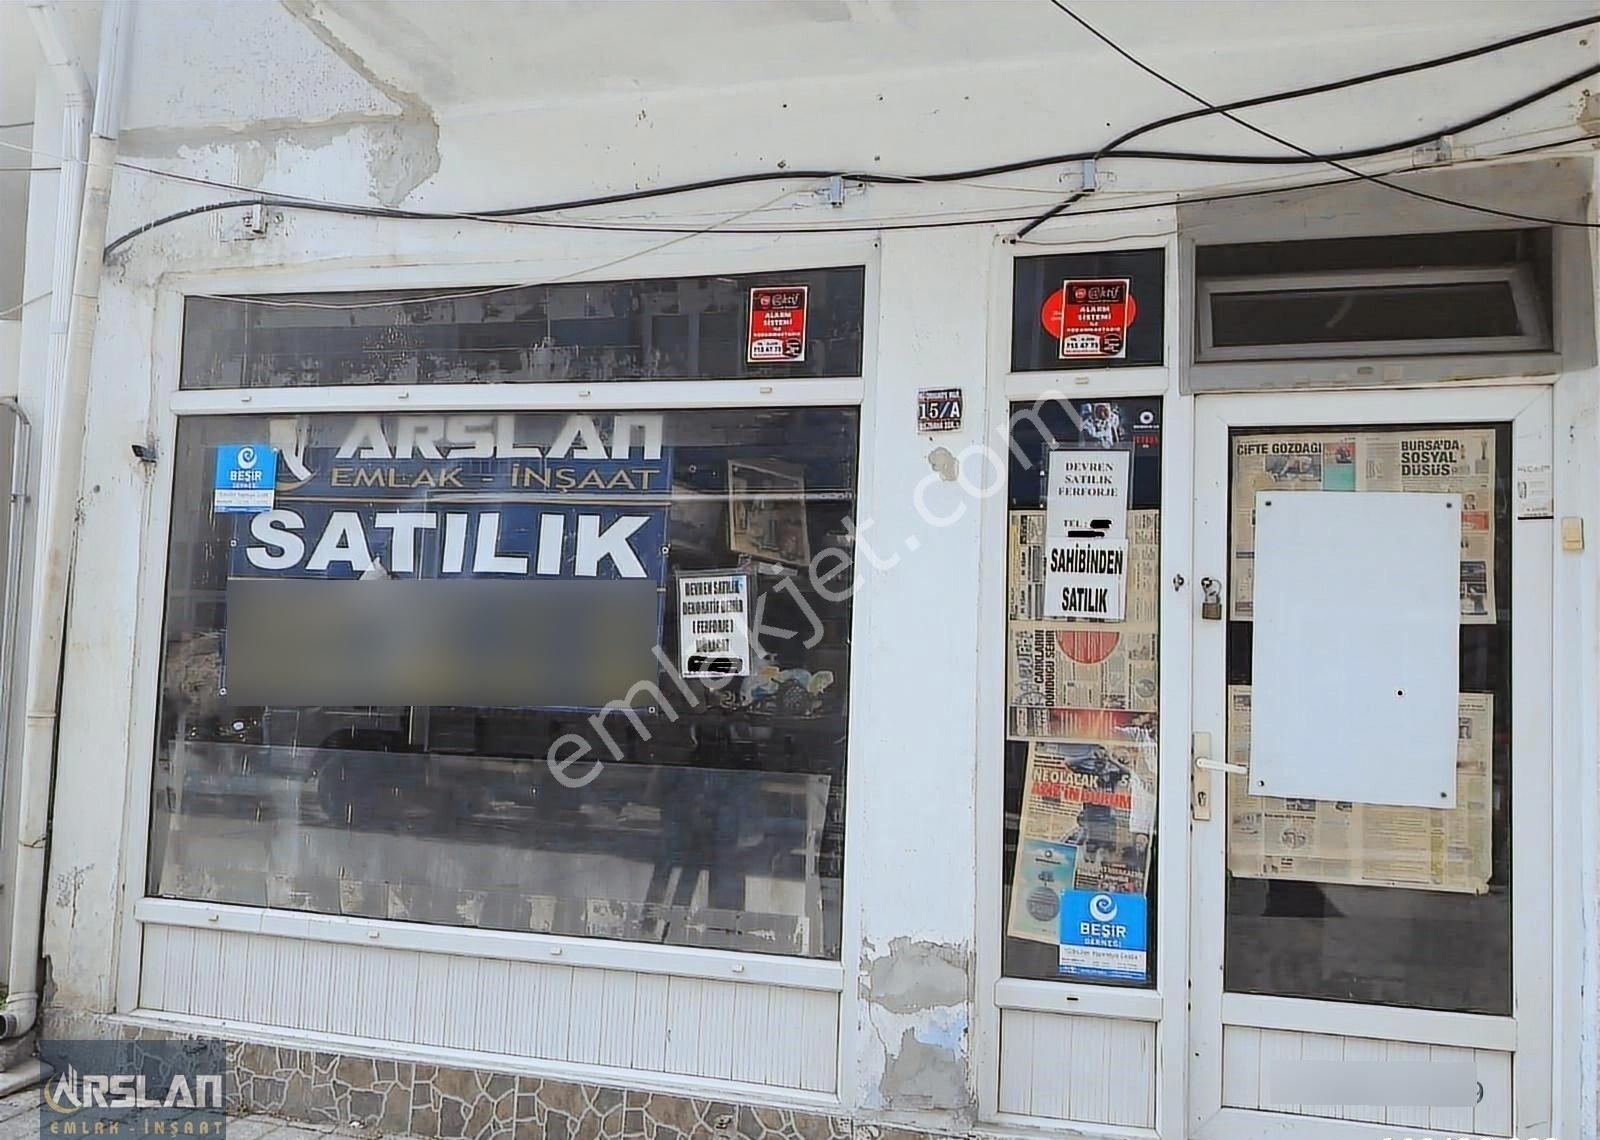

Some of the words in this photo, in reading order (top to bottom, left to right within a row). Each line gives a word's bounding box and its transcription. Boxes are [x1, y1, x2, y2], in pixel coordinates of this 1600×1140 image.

[920, 401, 960, 419] 15/A
[335, 414, 665, 461] ARSLAN
[1401, 440, 1460, 451] BURSA'DA
[1401, 451, 1457, 464] SOSYAL
[1065, 462, 1114, 472] DEVREN
[330, 466, 464, 489] EMLAK
[511, 463, 661, 494] İNŞAAT
[1064, 475, 1113, 485] SATILIK
[1058, 487, 1119, 497] FERFORJE
[246, 508, 652, 579] SATILIK
[1050, 543, 1124, 575] SAHİBİNDEN
[1061, 586, 1109, 613] SATILIK
[1080, 922, 1126, 938] BEŞİR
